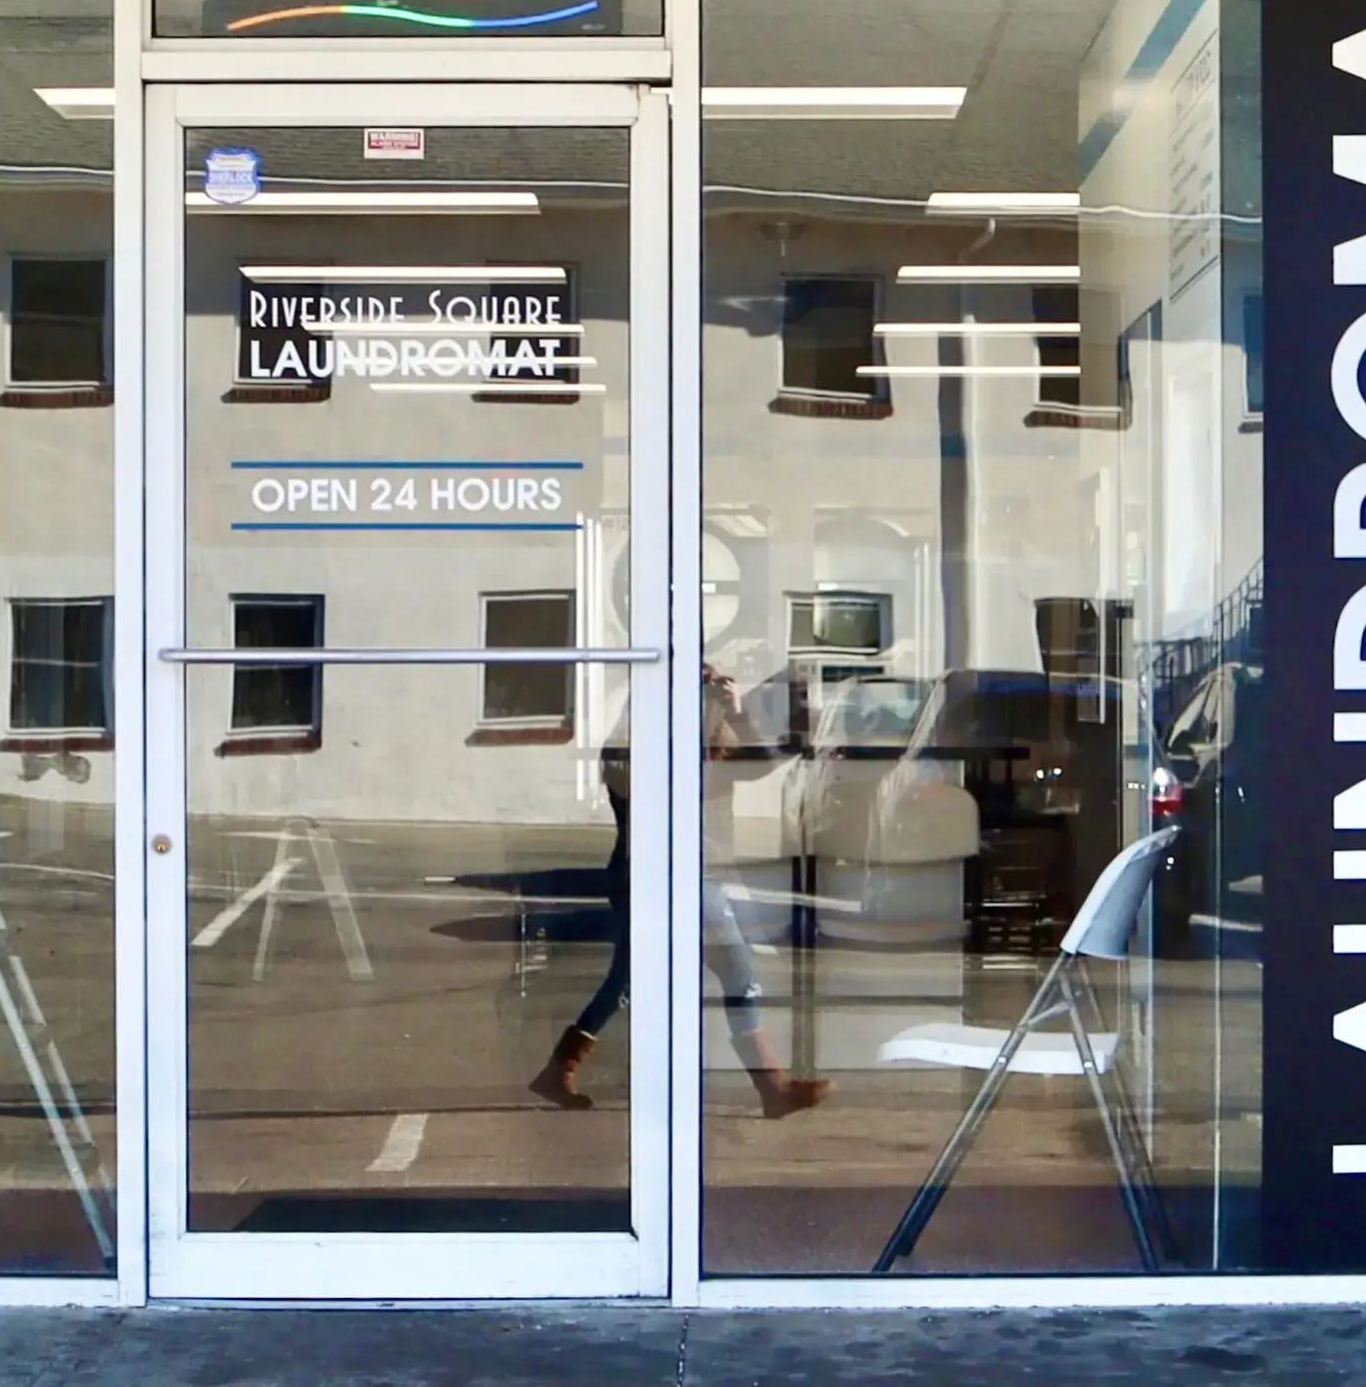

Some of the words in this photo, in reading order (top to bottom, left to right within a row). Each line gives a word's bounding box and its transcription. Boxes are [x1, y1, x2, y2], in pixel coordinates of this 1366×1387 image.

[249, 339, 561, 378] LAUNDROMAT
[251, 477, 358, 513] OPEN
[369, 477, 419, 512] 24
[430, 476, 563, 512] HOURS
